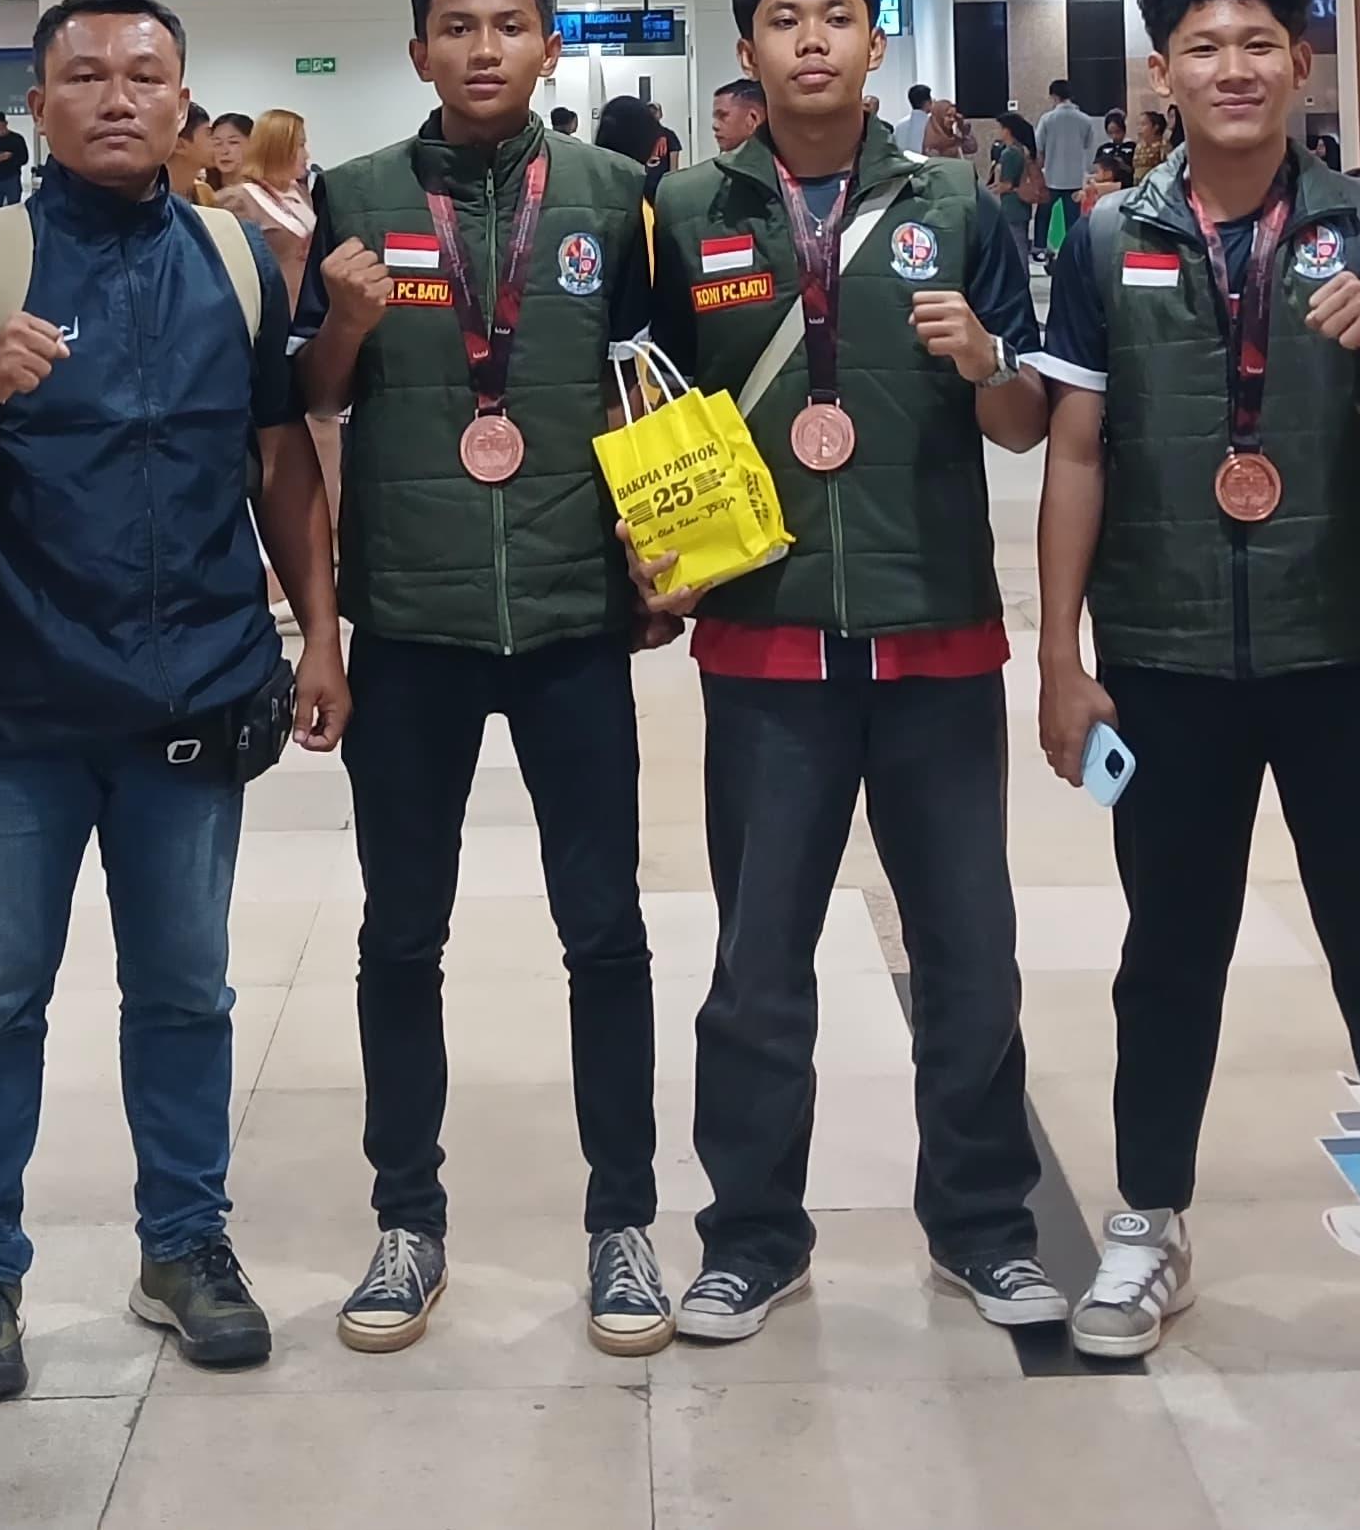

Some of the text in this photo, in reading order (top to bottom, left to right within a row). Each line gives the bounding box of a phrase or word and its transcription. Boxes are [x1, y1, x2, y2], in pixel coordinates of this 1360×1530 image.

[584, 13, 632, 24] MUSHOLLA
[616, 470, 662, 501] BAKPIA
[652, 477, 694, 519] 25
